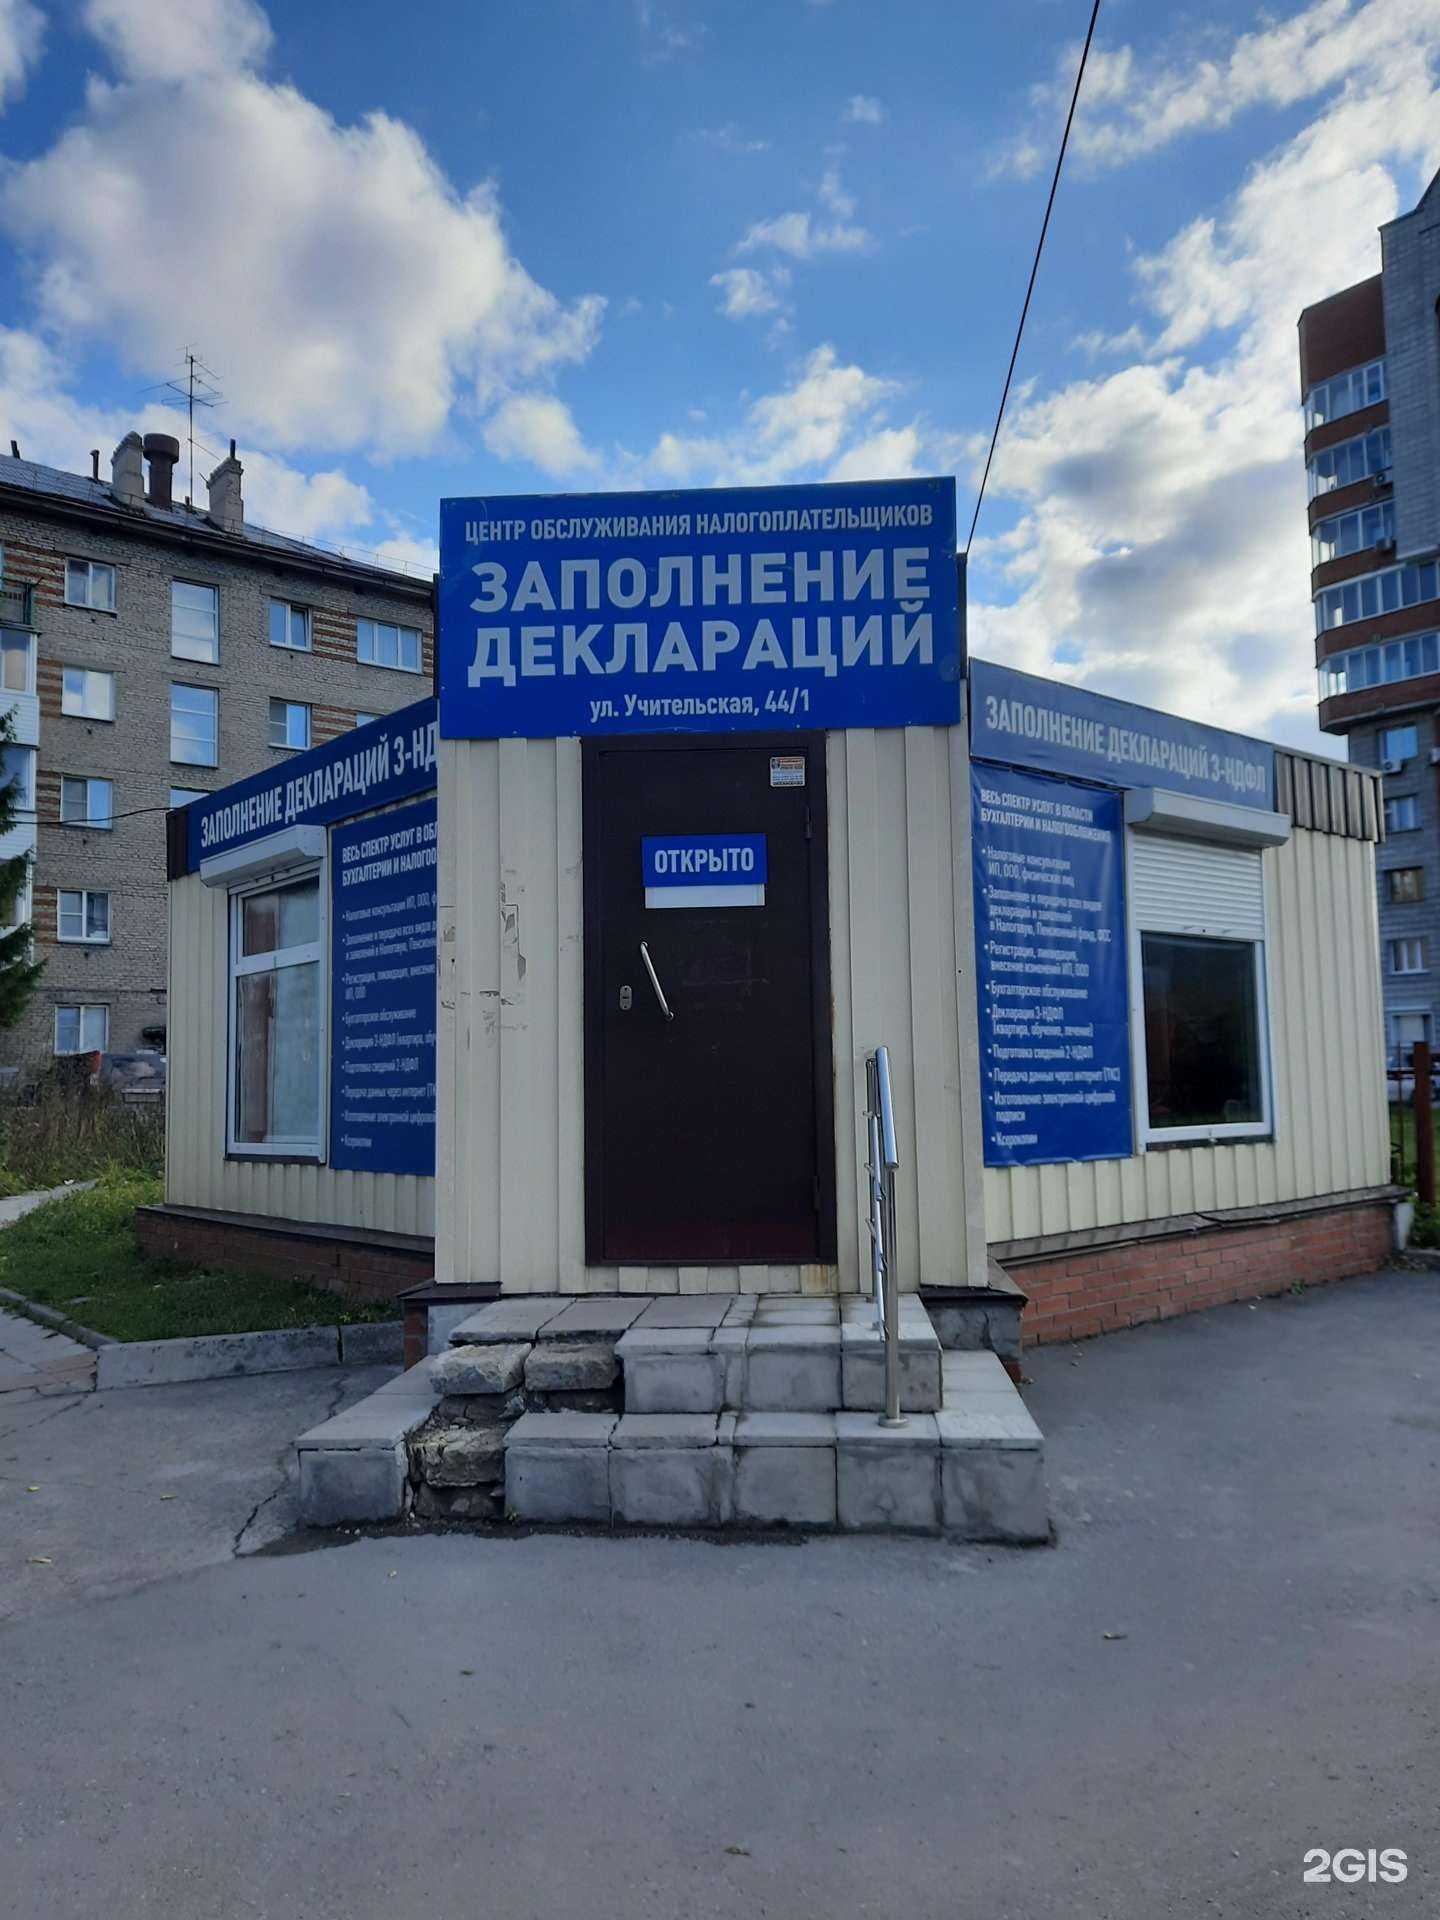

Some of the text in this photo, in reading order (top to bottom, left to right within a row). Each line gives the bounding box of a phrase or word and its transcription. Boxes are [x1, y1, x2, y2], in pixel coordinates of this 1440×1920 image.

[465, 504, 933, 545] ЦЕНТР ОБСЛУЖИВАНИЯ НАЛОГОПЛАТЕЛЬЩИКОВ
[469, 547, 931, 613] ЗАПОЛНЕНИЕ
[467, 600, 934, 688] ДЕКЛАРАЦИЙ
[590, 688, 811, 722] ул. Учительская, 44/1
[986, 696, 1266, 793] ЗАПОЛНЕНИЕ ДЕКЛАРАЦИЙ 3-НДФЛ
[201, 720, 438, 848] ЗАПОЛНЕНИЕ ДЕКЛАРАЦИЙ 3-НД
[981, 788, 1000, 805] ВЕСЬ
[1001, 793, 1030, 810] СПЕКТР
[1056, 803, 1061, 816] В
[981, 807, 1034, 830] БУХГАЛТЕРИИ
[1035, 818, 1041, 831] И
[342, 844, 360, 864] ВЕСЬ
[361, 836, 389, 858] СПЕКТР
[390, 828, 415, 851] УСЛУГ
[416, 826, 422, 844] В
[654, 848, 754, 873] ОТКРЫТО
[342, 859, 392, 887] БУХГАЛТЕРИИ
[393, 857, 400, 874] И
